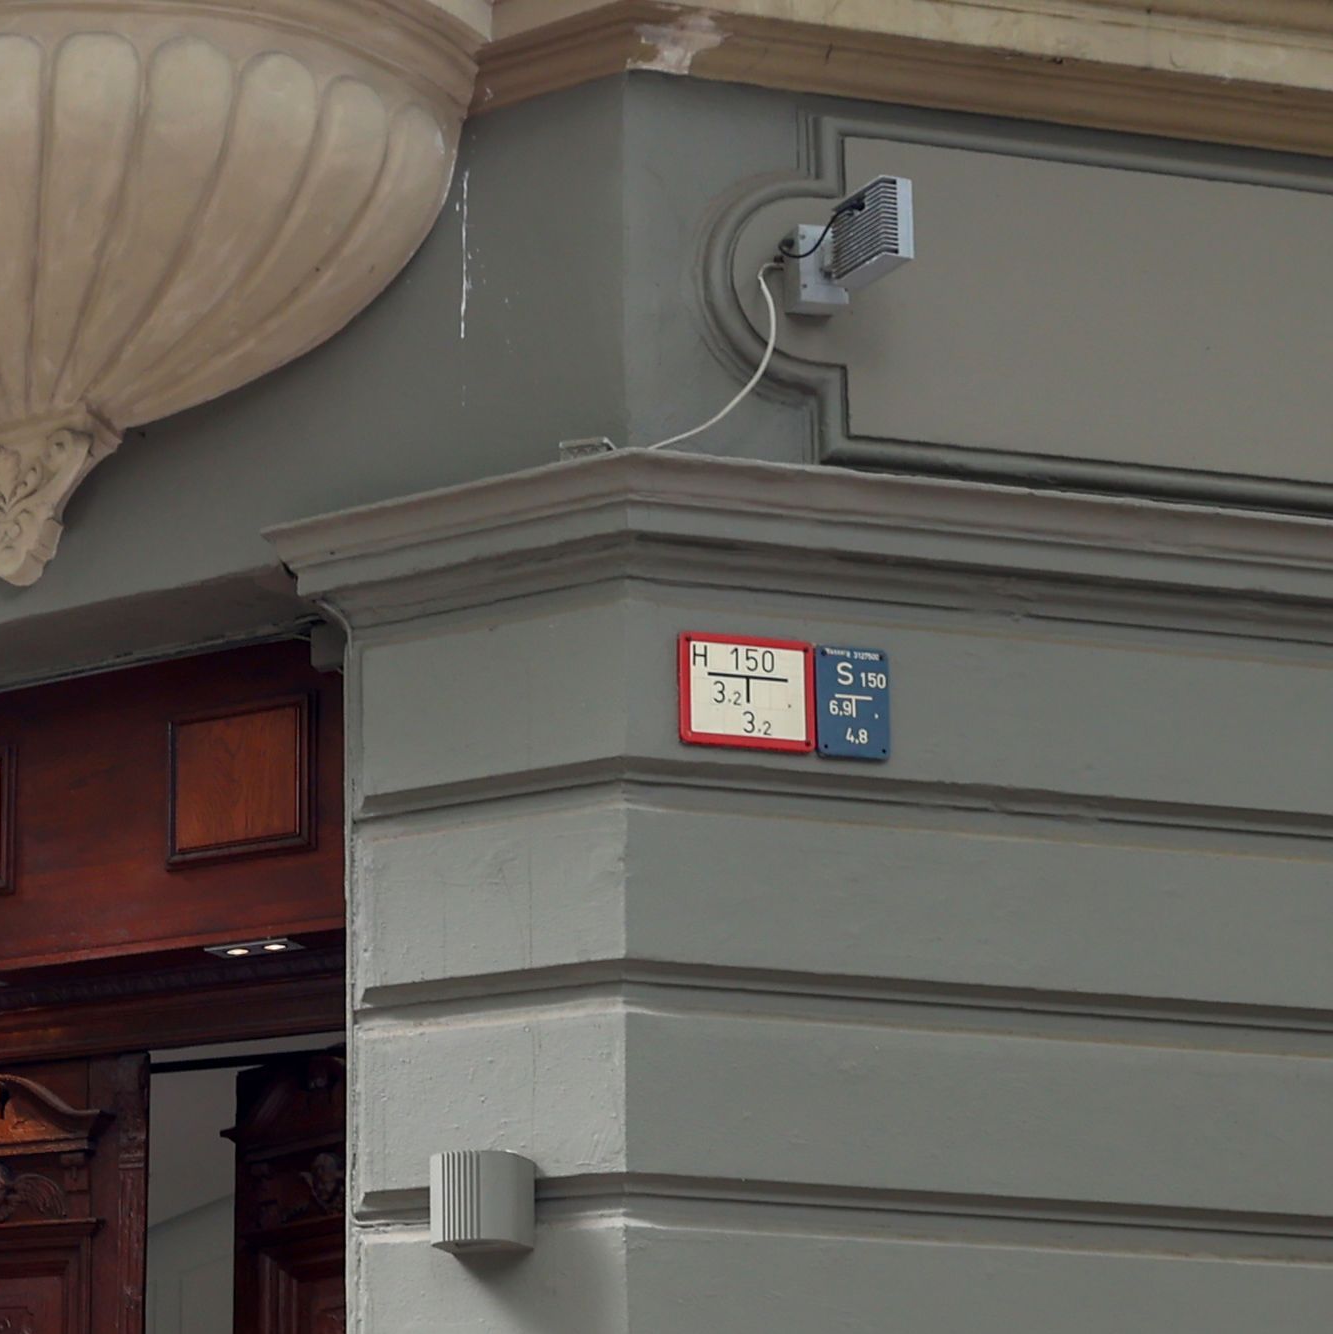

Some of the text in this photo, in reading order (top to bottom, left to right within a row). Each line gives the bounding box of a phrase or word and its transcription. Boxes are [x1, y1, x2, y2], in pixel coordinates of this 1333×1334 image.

[692, 644, 775, 673] H 150
[836, 661, 887, 689] S 150
